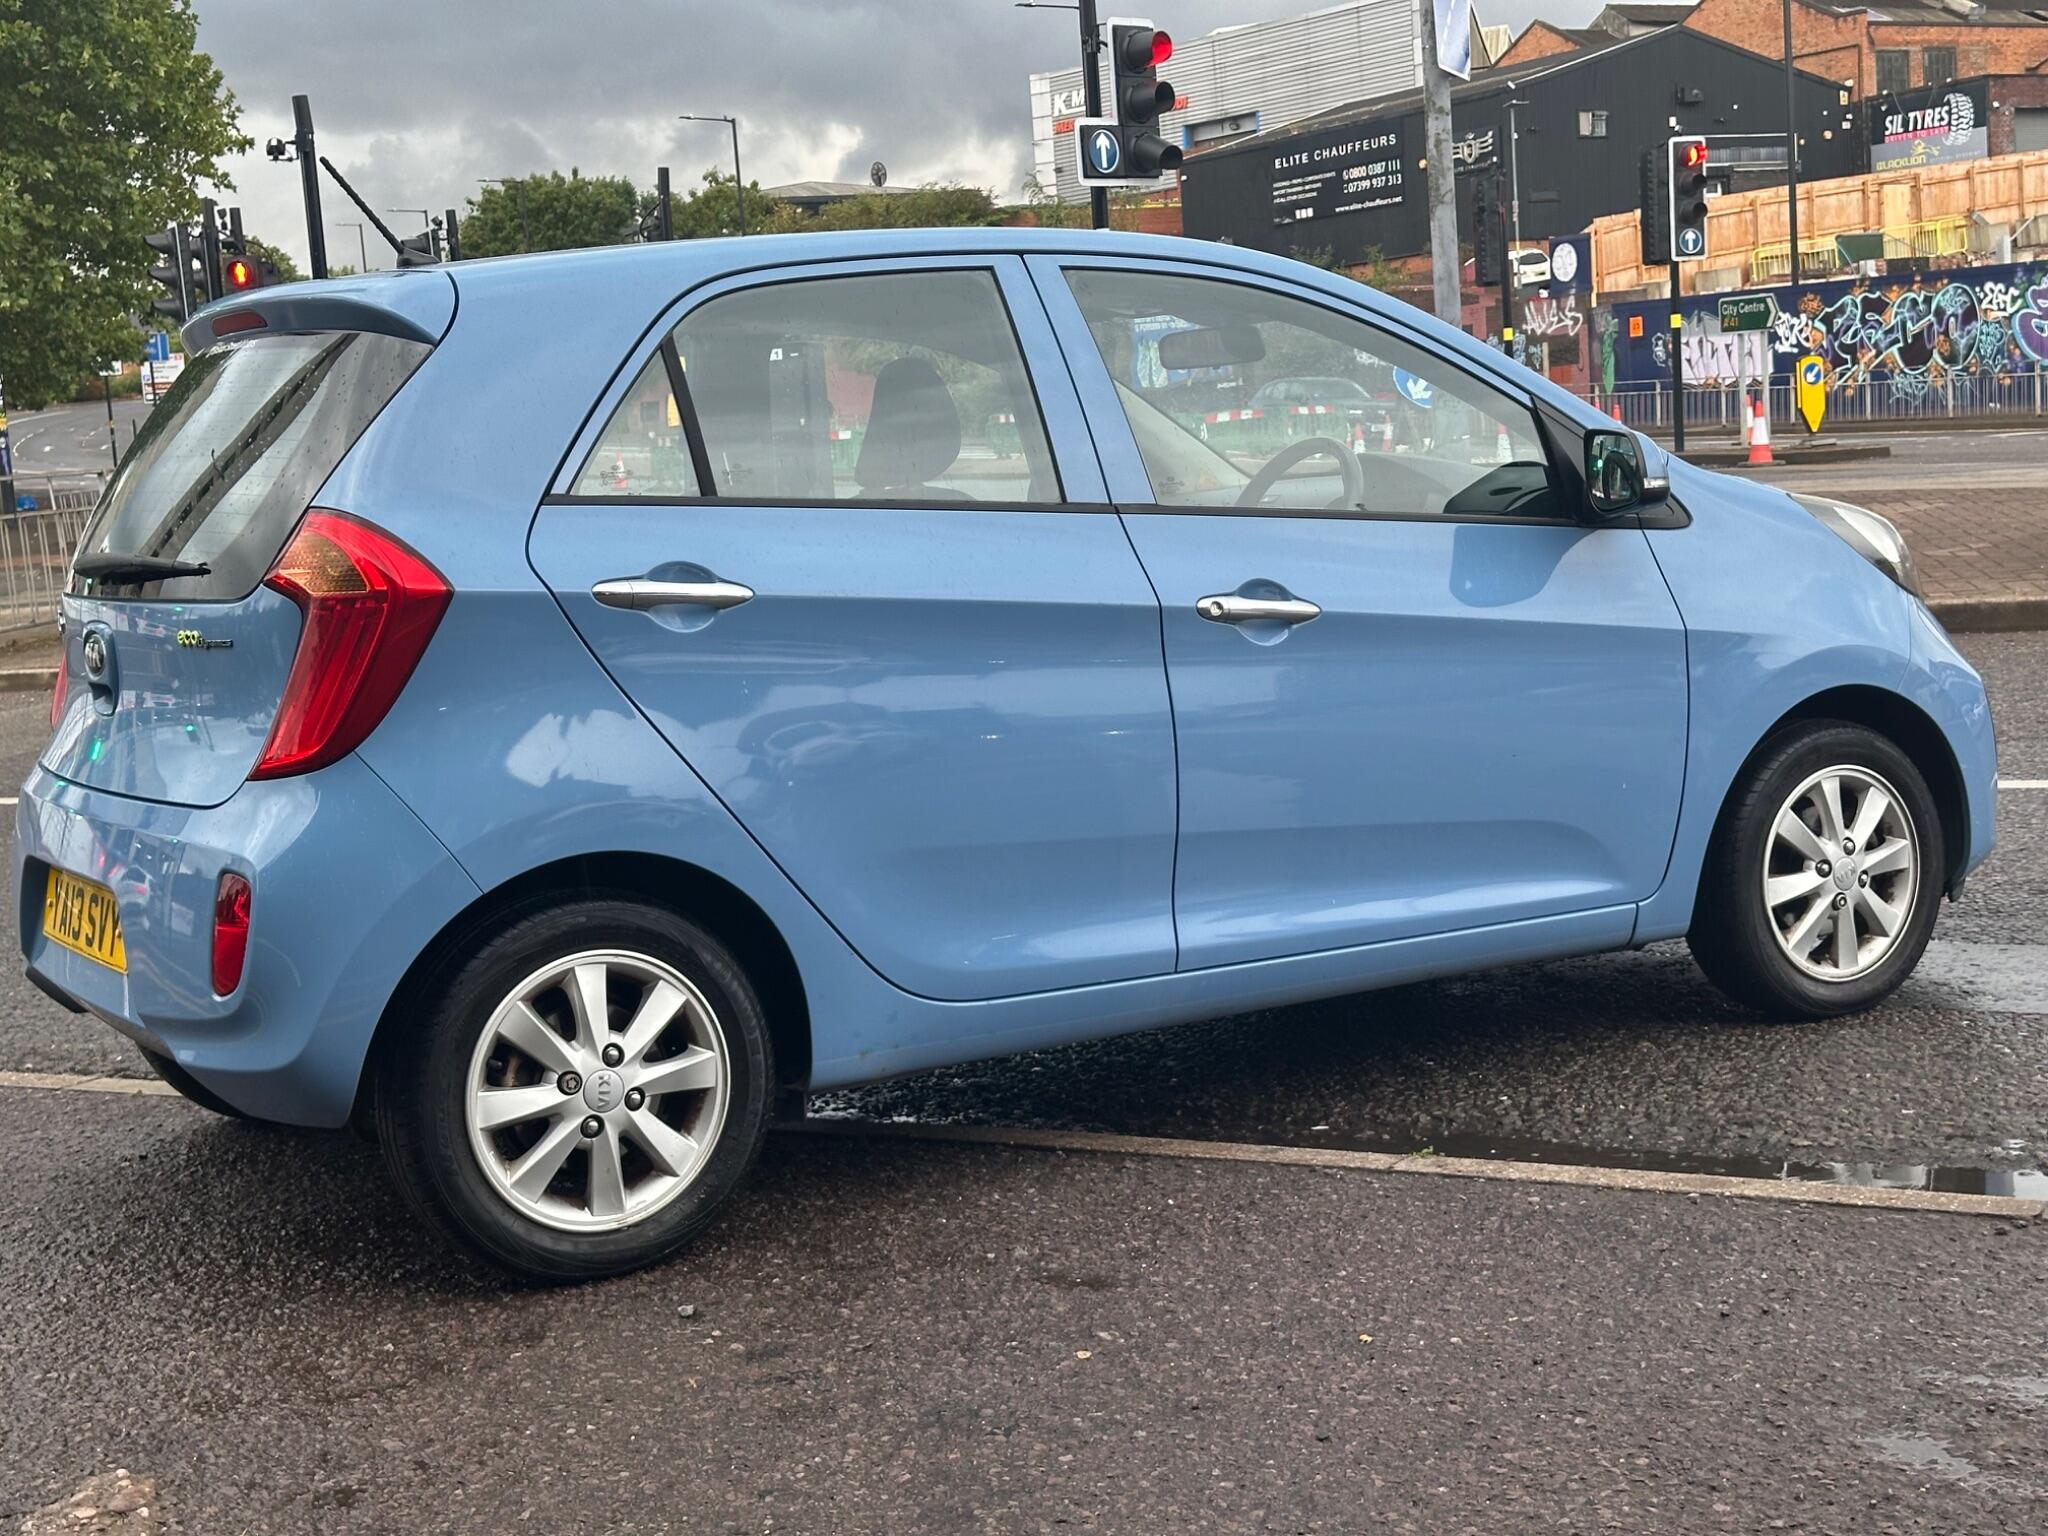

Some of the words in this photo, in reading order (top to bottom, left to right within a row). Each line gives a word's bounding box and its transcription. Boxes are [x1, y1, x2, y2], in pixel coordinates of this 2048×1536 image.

[1884, 114, 1904, 136] SIL
[1907, 105, 1950, 132] TYRES
[1274, 152, 1309, 169] ELITE
[1314, 134, 1397, 160] CHAUFFEURS
[1347, 179, 1371, 193] 07399
[1371, 176, 1386, 190] 937
[1387, 173, 1402, 187] 313
[1348, 166, 1367, 180] 0800
[1367, 161, 1386, 176] 0387
[1387, 158, 1401, 172] 111
[1722, 304, 1738, 316] City
[1738, 302, 1765, 313] Centre
[52, 876, 85, 941] YA13
[85, 893, 121, 958] SVY
[597, 1074, 611, 1110] KIA
